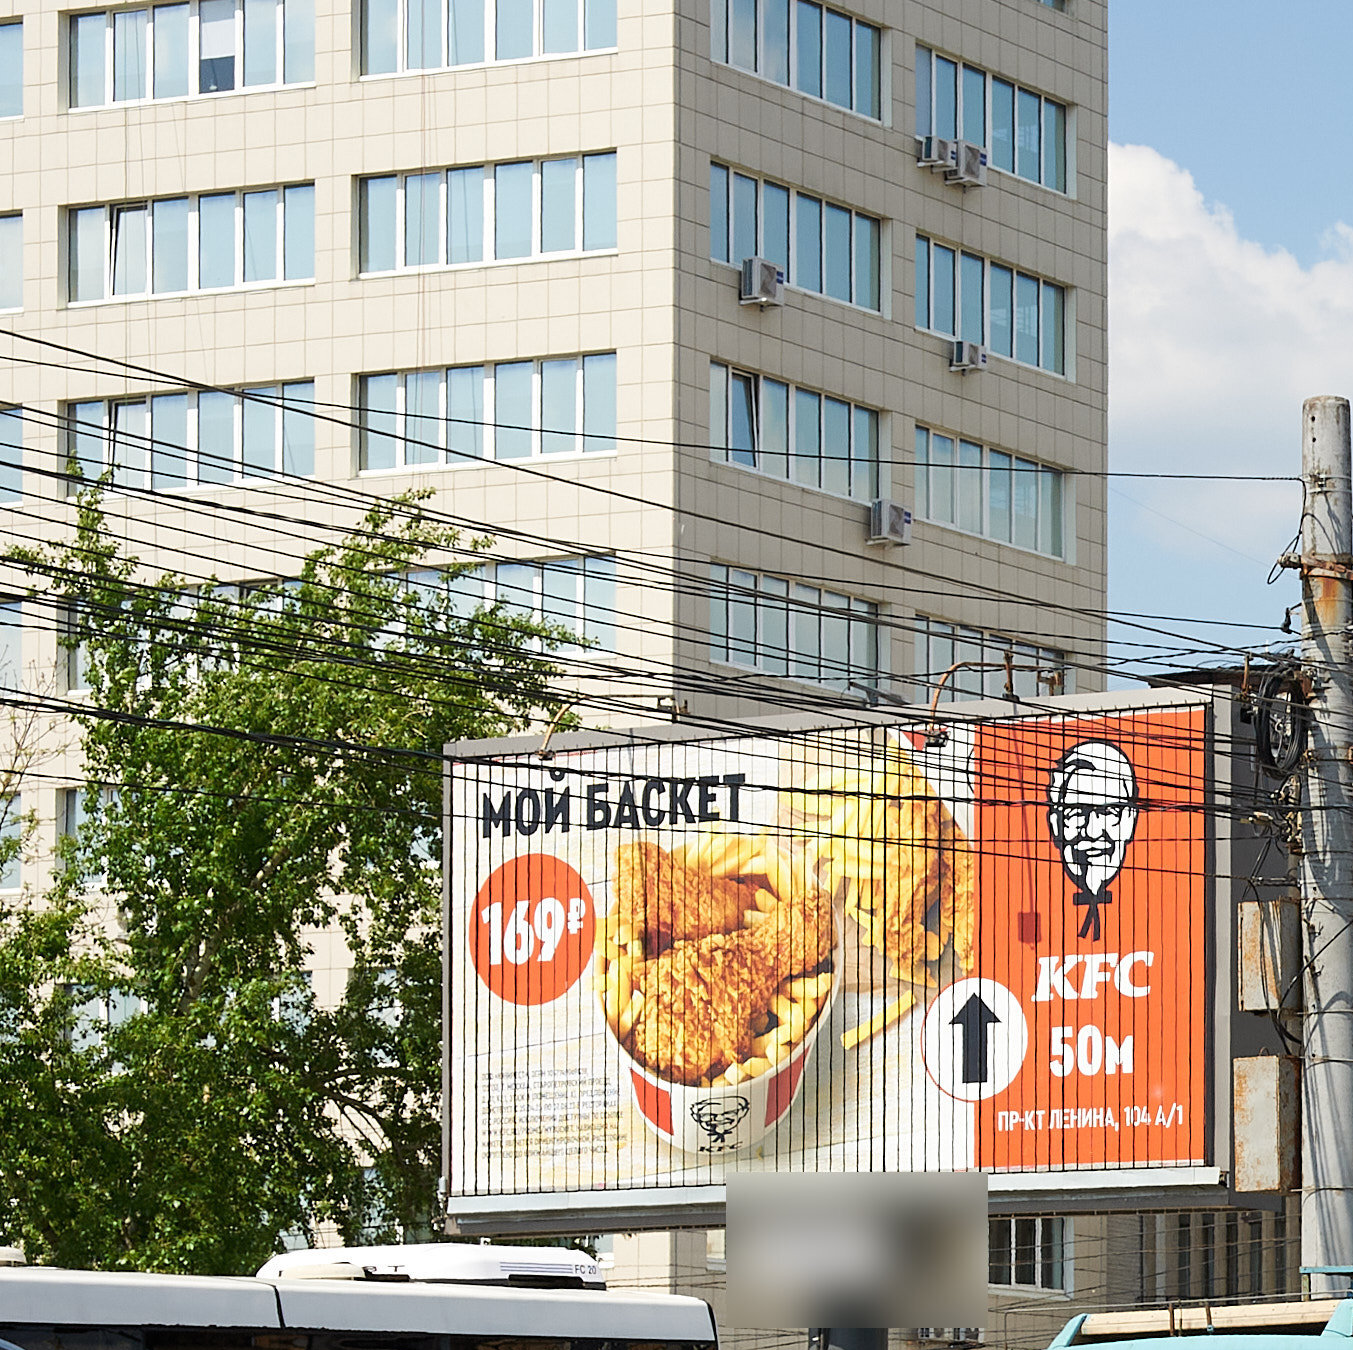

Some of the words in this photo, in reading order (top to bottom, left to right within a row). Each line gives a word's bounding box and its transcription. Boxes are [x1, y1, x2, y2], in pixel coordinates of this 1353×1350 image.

[483, 768, 570, 838] МОЙ
[587, 772, 746, 831] БАСКЕТ
[1031, 951, 1154, 1002] KFC
[998, 1109, 1046, 1131] ПР-КТ
[1049, 1106, 1119, 1131] ЛЕНИНА,
[1124, 1106, 1151, 1127] 104
[1155, 1103, 1183, 1128] А/1
